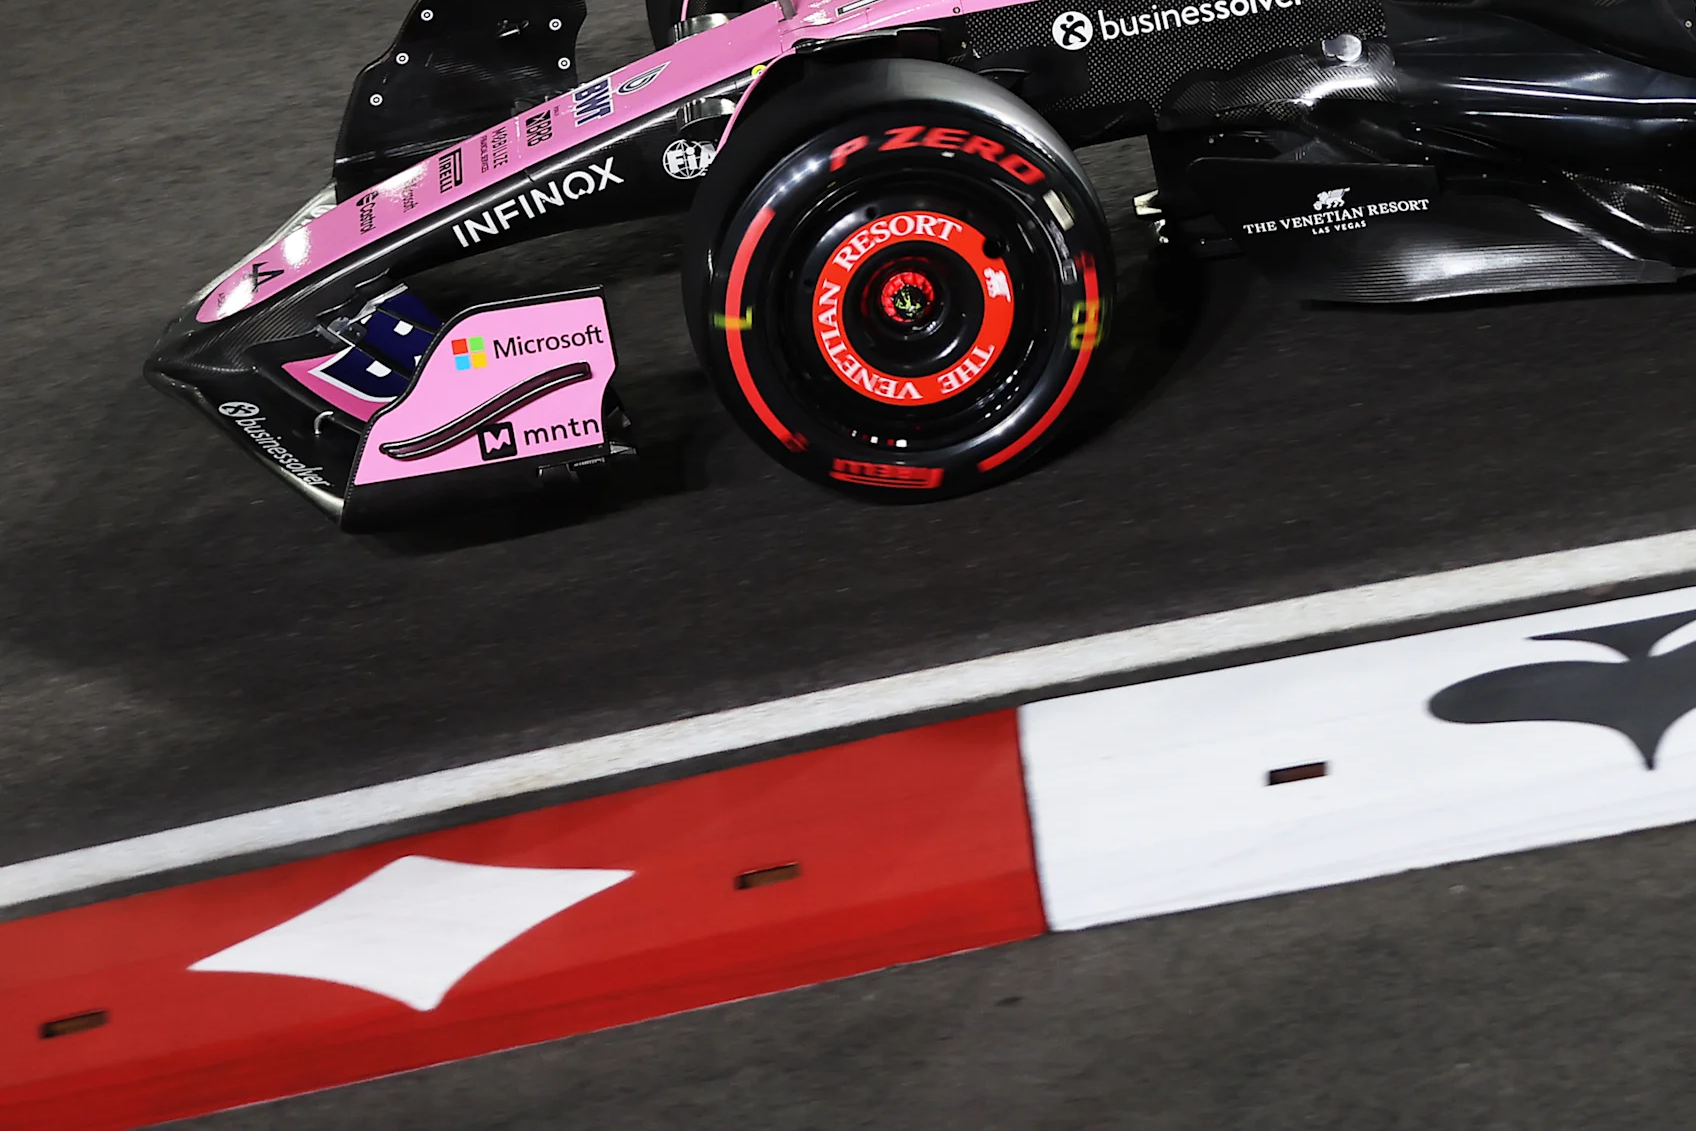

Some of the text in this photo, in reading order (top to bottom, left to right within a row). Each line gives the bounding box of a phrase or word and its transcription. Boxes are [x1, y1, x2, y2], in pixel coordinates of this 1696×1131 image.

[572, 76, 615, 128] BWT
[438, 147, 463, 195] PIRELLI
[829, 124, 1047, 185] P ZERO
[359, 202, 376, 236] Castrol
[452, 155, 625, 248] INFINOX
[1243, 198, 1430, 235] THE VENETIAN RESORT
[1312, 220, 1367, 236] LAS VEGAS
[817, 213, 996, 401] THE VENETIAN RESORT
[493, 324, 605, 360] Microsoft
[234, 417, 332, 487] businessolver
[523, 417, 601, 447] mntn
